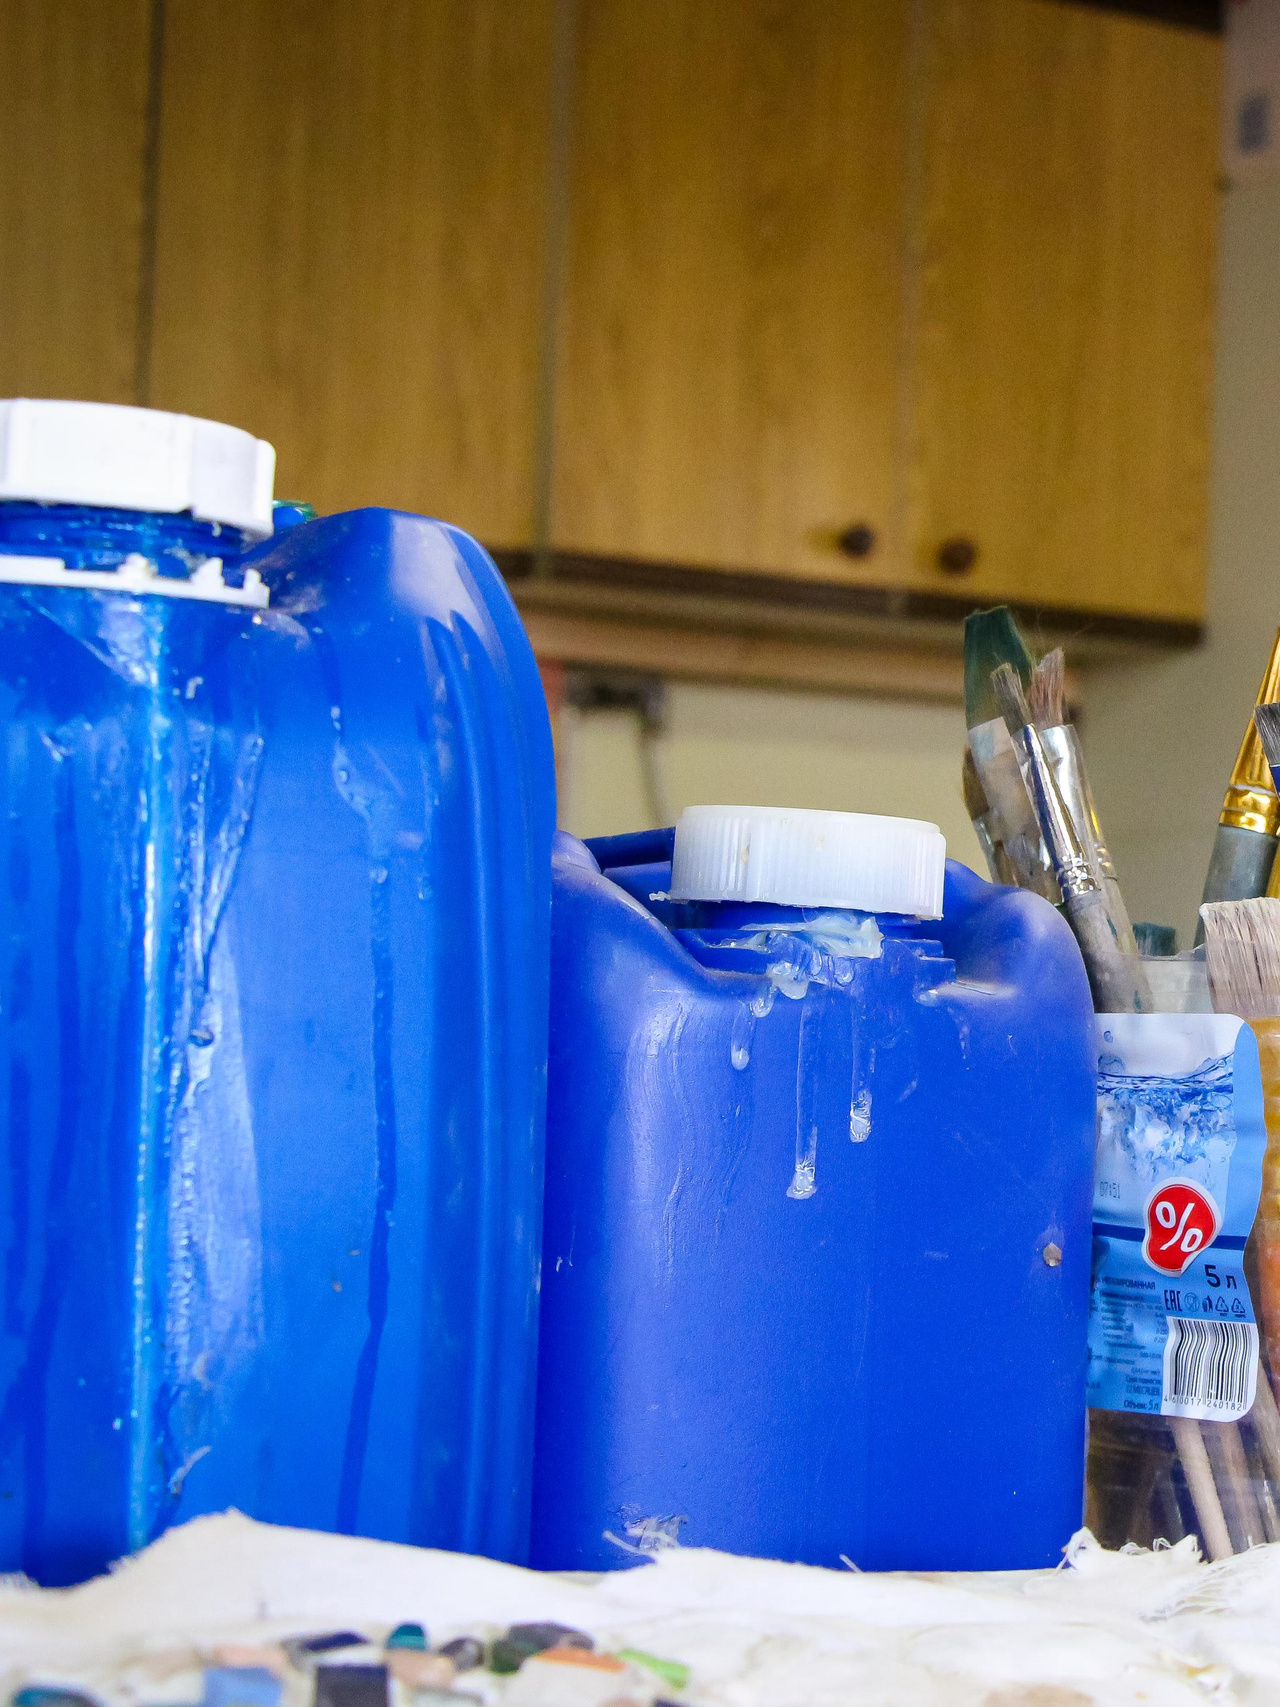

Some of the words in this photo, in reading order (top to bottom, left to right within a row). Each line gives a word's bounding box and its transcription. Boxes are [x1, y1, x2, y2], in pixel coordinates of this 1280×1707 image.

[1204, 1264, 1221, 1287] 5
[1226, 1275, 1238, 1289] л
[1206, 1399, 1242, 1411] 240182
